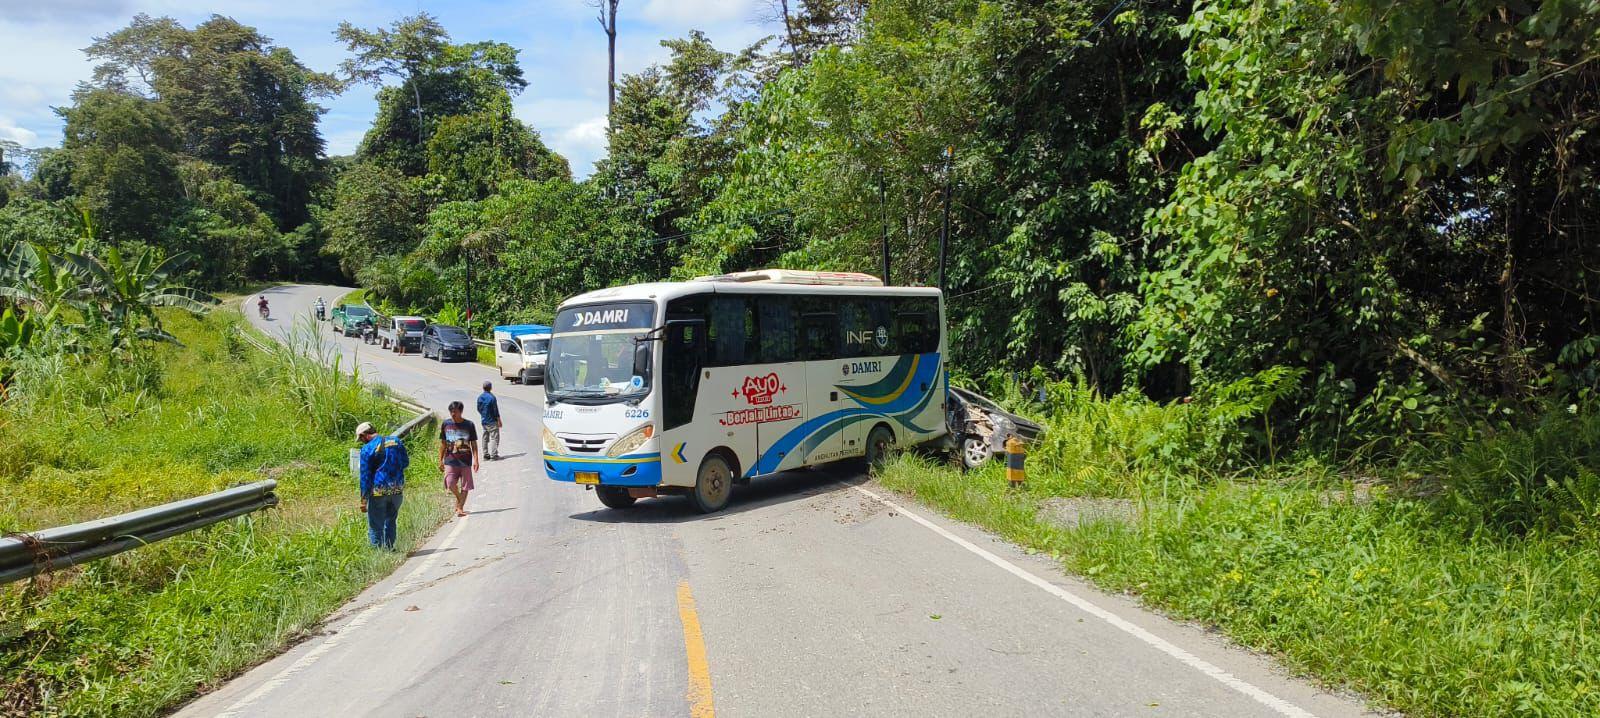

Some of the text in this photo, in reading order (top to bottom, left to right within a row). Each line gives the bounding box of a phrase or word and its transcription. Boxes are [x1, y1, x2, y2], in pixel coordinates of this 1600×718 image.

[583, 309, 629, 325] DAMRI
[852, 361, 882, 374] DAMRI
[625, 409, 649, 418] 6226
